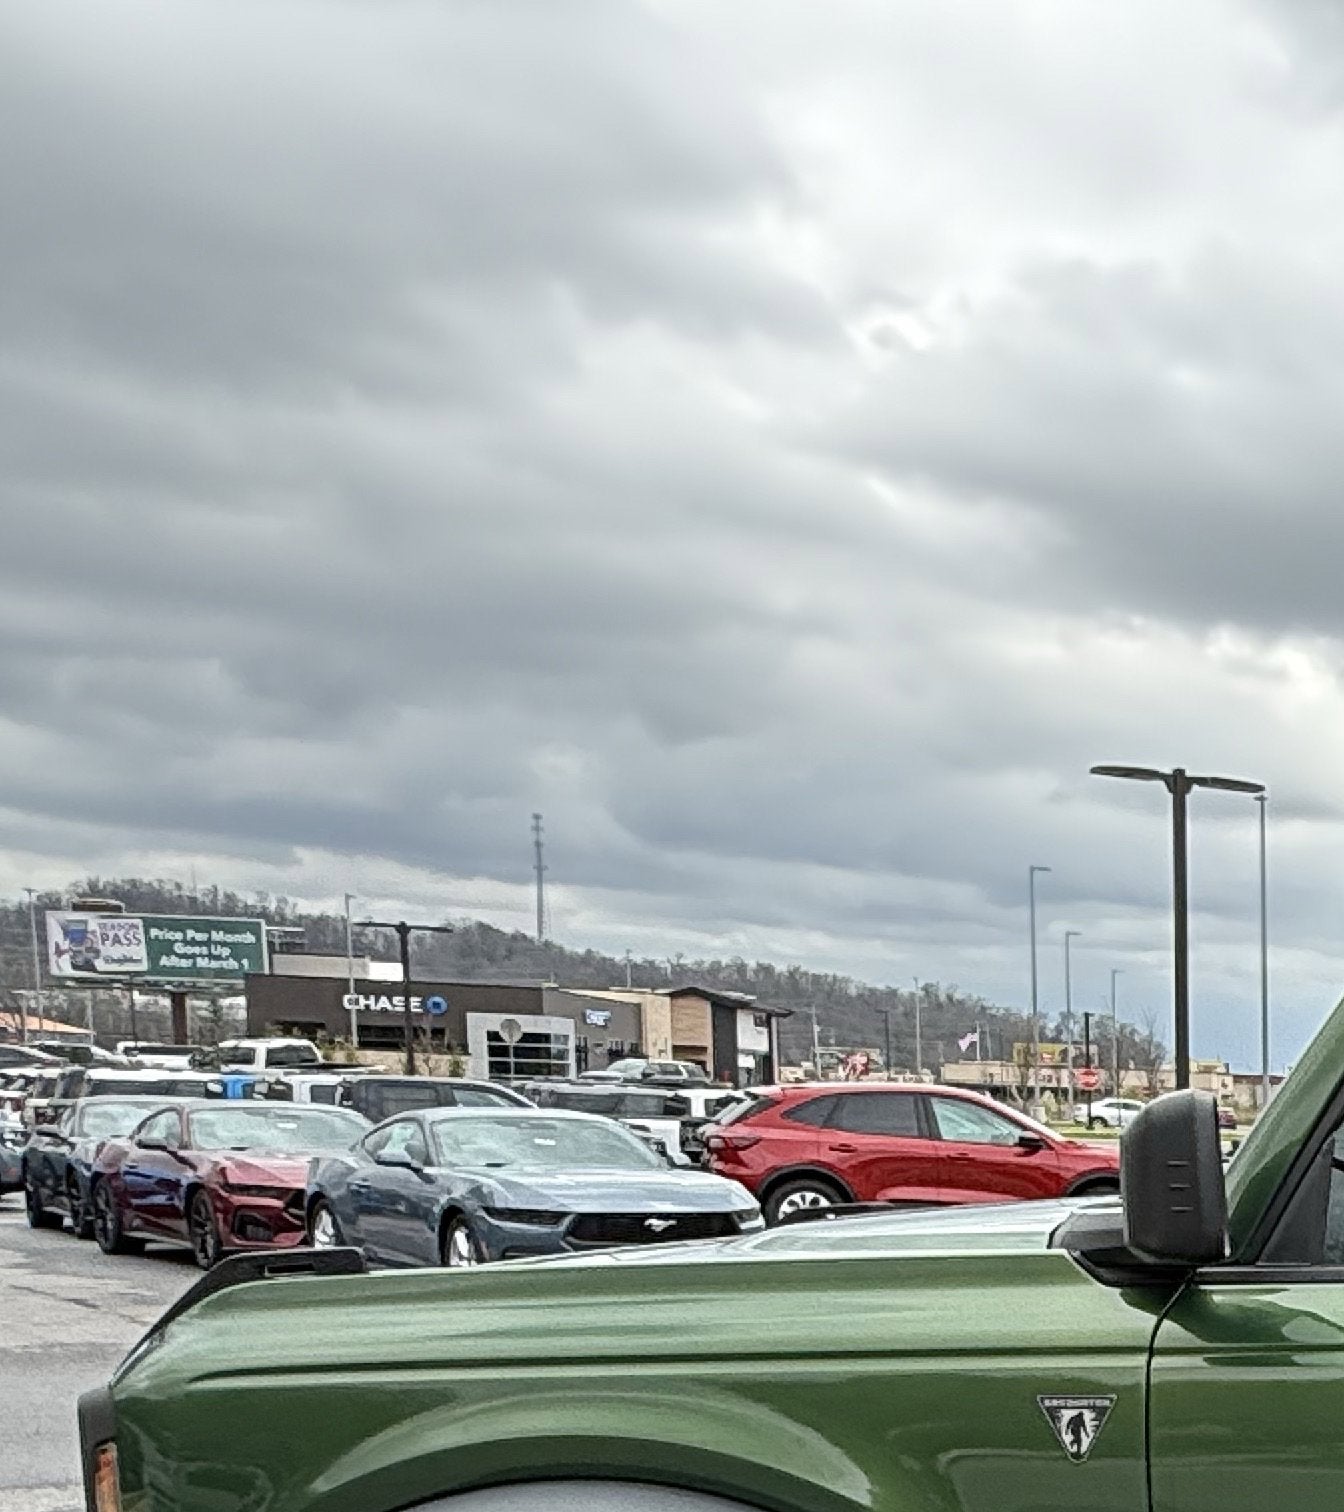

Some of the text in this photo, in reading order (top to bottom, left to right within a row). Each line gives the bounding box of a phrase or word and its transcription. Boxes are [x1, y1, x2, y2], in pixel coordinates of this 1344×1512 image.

[100, 932, 142, 947] PASS
[149, 928, 256, 944] Price Per Month
[173, 942, 232, 958] Goes Up
[160, 954, 250, 970] After March 1
[342, 994, 424, 1013] CHASE
